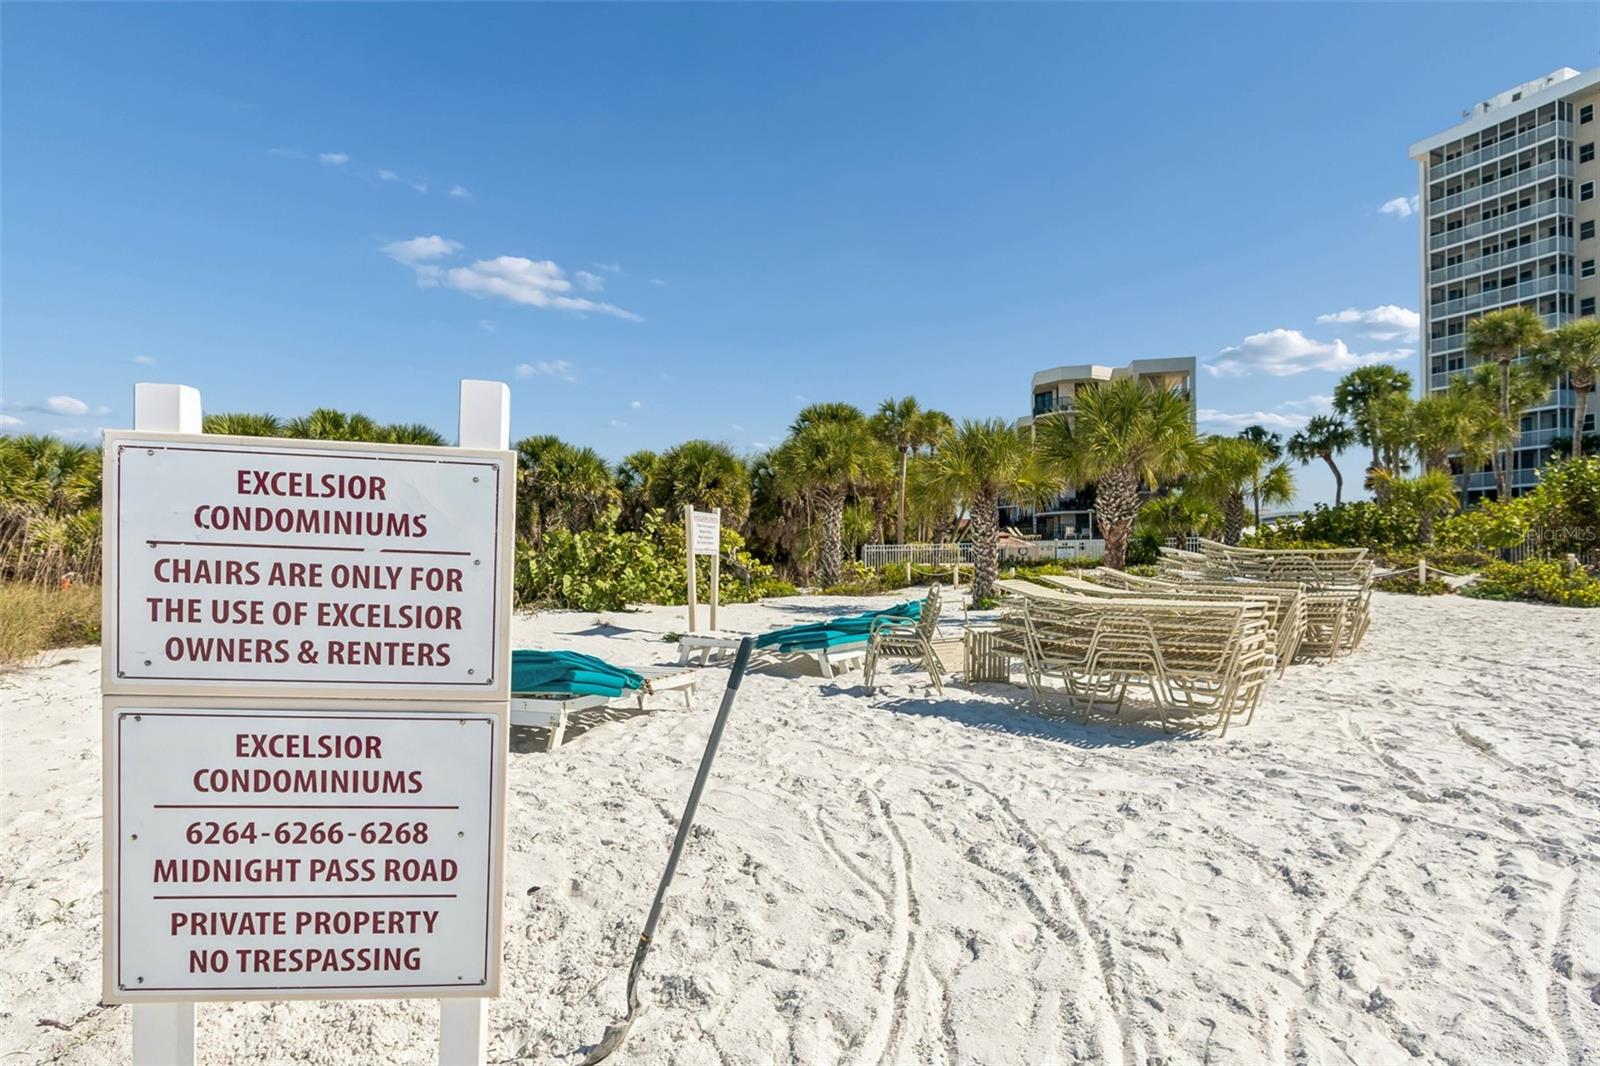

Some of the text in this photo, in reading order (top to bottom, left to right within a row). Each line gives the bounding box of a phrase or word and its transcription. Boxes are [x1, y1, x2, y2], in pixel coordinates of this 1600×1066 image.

[237, 470, 386, 500] EXCELSIOR
[194, 505, 427, 537] CONDOMINIUMS
[154, 558, 463, 592] CHAIRS ARE ONLY FOR
[146, 598, 462, 630] THE USE OF EXCELSIOR
[165, 636, 451, 667] OWNERS & RENTERS
[235, 734, 382, 759] EXCELSIOR
[193, 768, 423, 794] CONDOMINIUMS
[186, 821, 428, 845] 6264-6266-6268
[153, 858, 458, 883] MIDNIGHT PASS ROAD
[171, 910, 439, 936] PRIVATE PROPERTY
[189, 947, 421, 973] NO TRESPASSING
